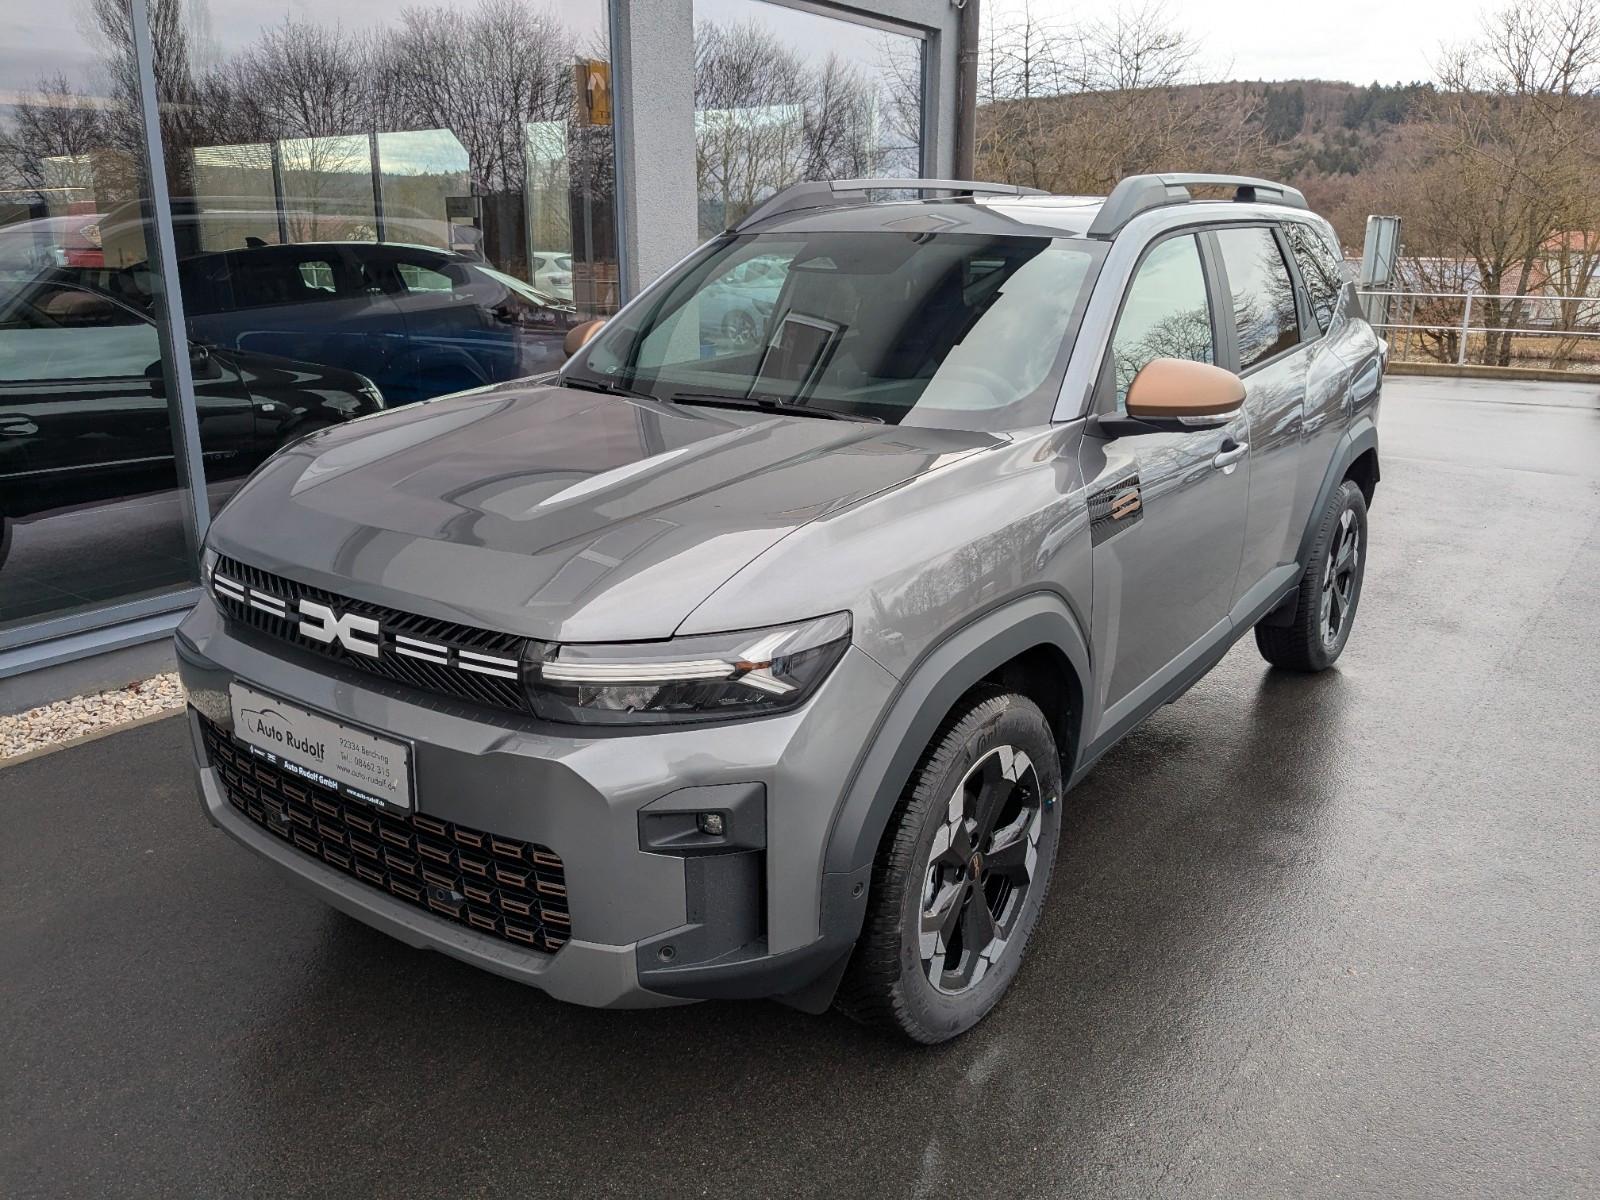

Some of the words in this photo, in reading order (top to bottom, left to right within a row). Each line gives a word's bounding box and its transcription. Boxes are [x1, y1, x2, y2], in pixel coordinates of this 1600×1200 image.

[257, 719, 283, 742] Auto
[286, 730, 325, 760] Rudolf
[284, 760, 298, 773] Auto
[298, 766, 319, 782] Rudolf
[319, 775, 338, 790] GmbH
